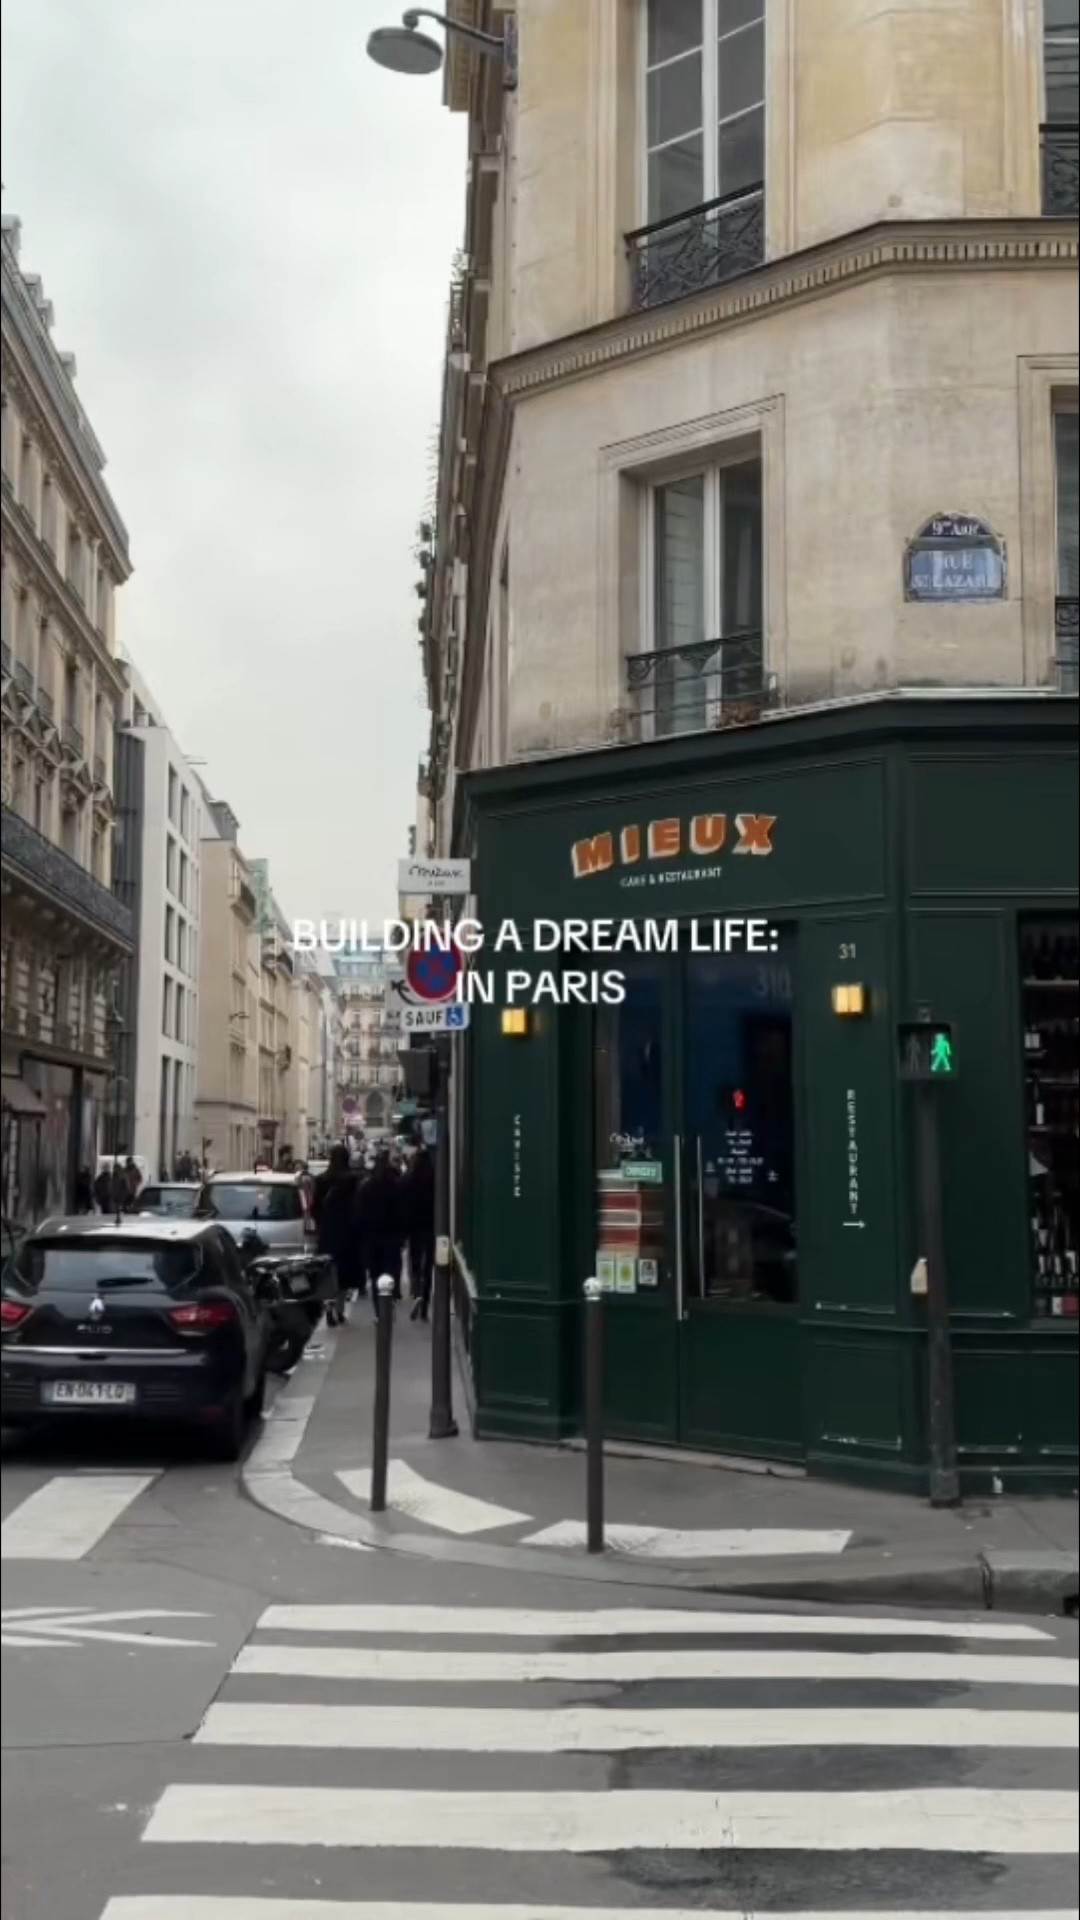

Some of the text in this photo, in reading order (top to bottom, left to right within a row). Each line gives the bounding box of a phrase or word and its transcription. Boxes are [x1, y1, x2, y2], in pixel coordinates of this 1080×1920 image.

[932, 573, 1000, 588] LAZAR
[571, 813, 777, 879] MIEUX
[658, 866, 722, 884] RESTAURANT
[839, 942, 857, 959] 31
[404, 1009, 443, 1027] SAUF
[845, 1088, 859, 1215] RESTAURANT
